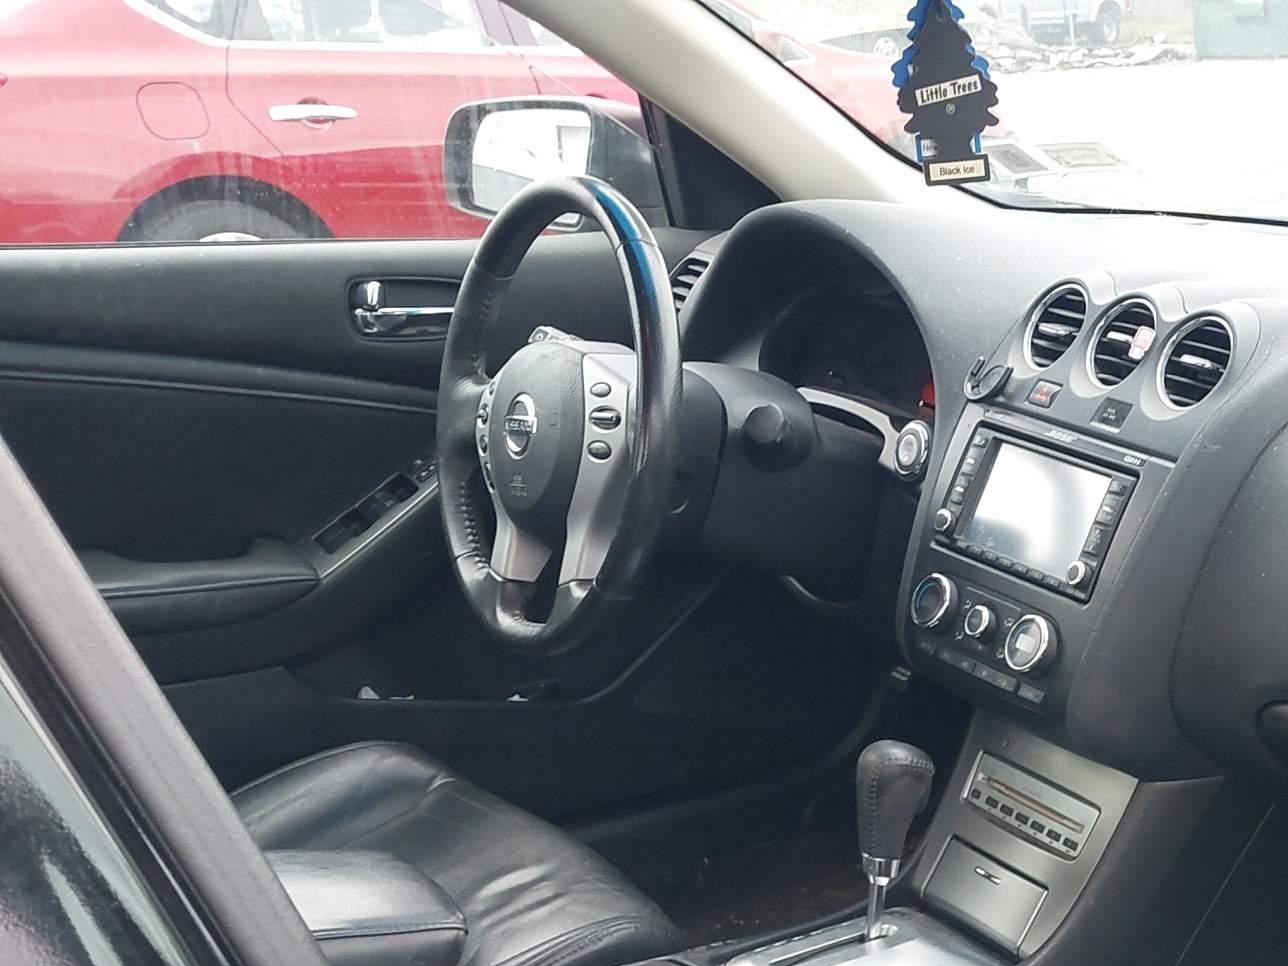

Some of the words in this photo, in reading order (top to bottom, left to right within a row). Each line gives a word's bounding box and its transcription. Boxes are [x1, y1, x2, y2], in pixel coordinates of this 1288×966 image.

[920, 85, 948, 104] Little
[950, 80, 978, 95] Trees
[939, 166, 961, 176] Black
